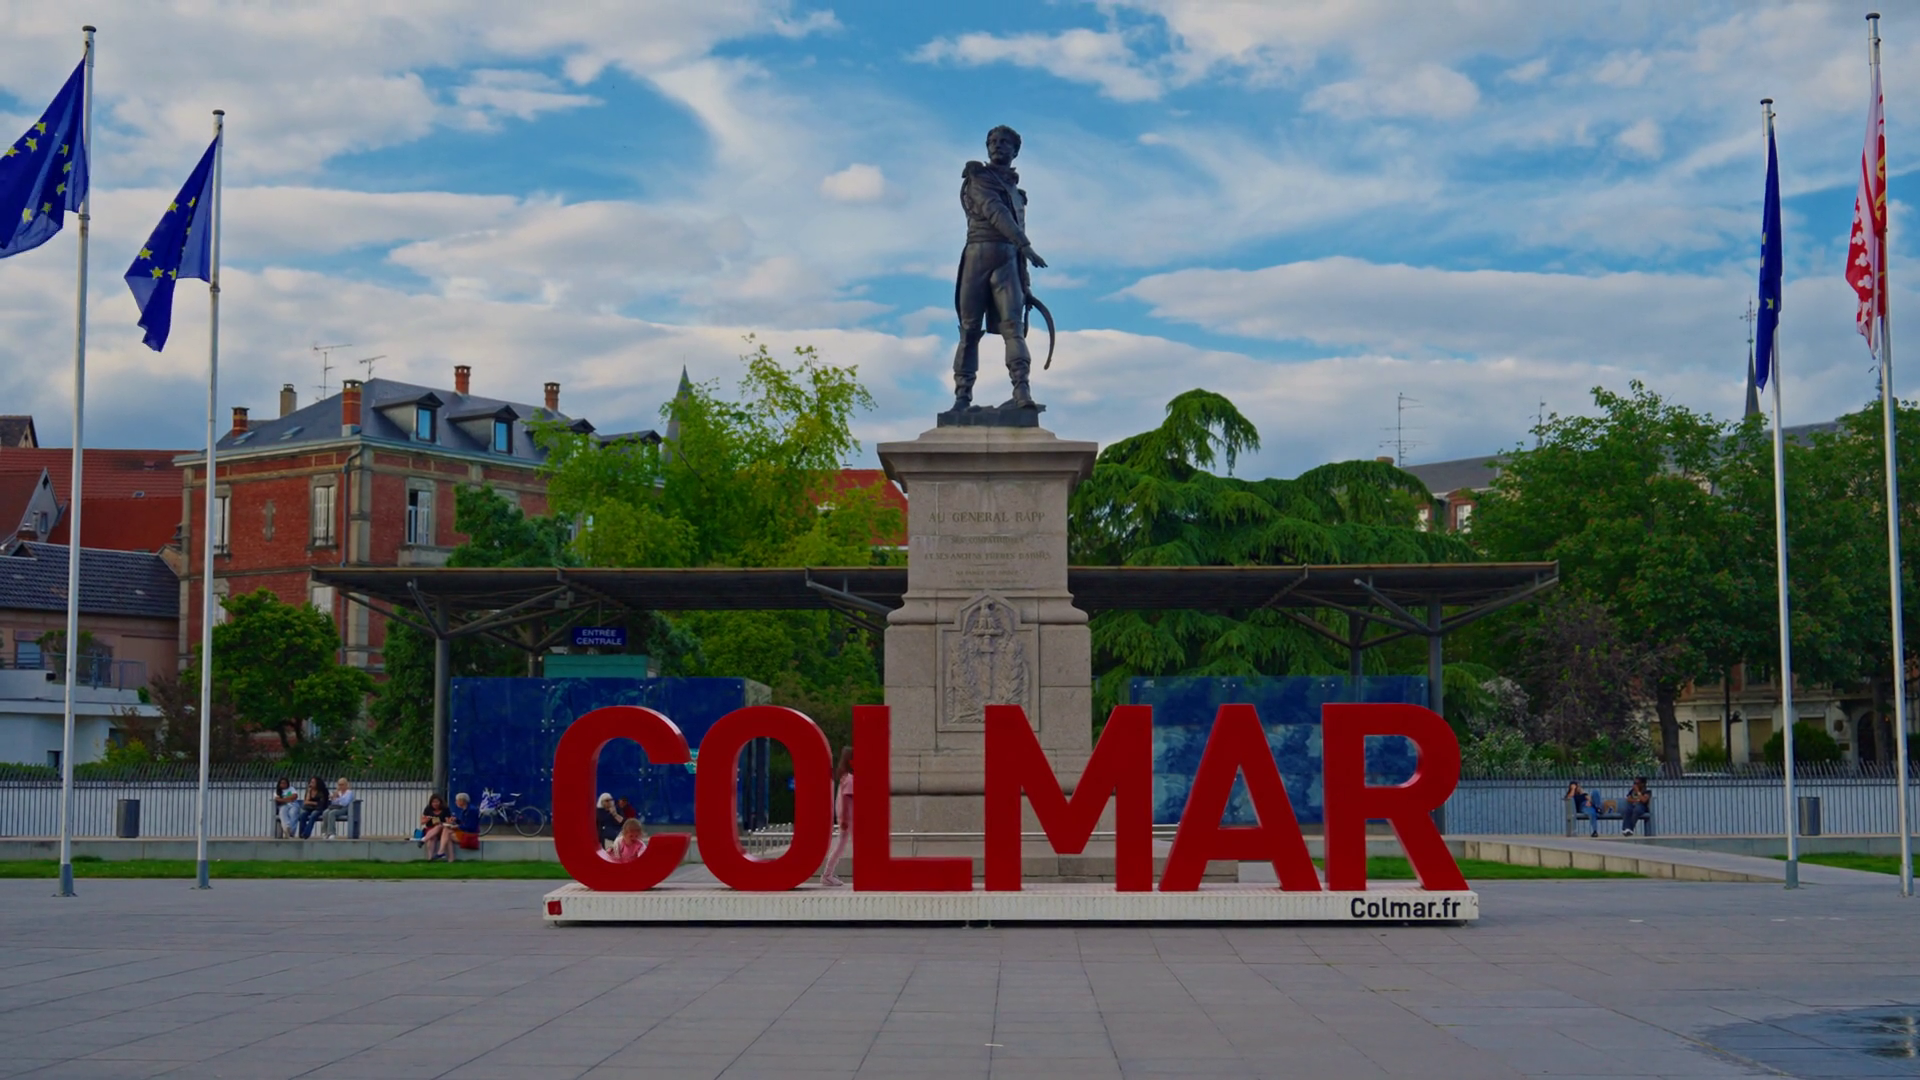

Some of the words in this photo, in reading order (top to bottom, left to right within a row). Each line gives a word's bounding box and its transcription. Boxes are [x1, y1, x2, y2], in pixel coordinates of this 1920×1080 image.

[928, 511, 945, 523] AU
[1015, 511, 1046, 523] RAPP
[582, 628, 617, 637] ENTRÉE
[575, 637, 622, 645] CENTRALE
[551, 702, 1470, 892] COLMAR
[1351, 897, 1461, 918] Colmar.fr
